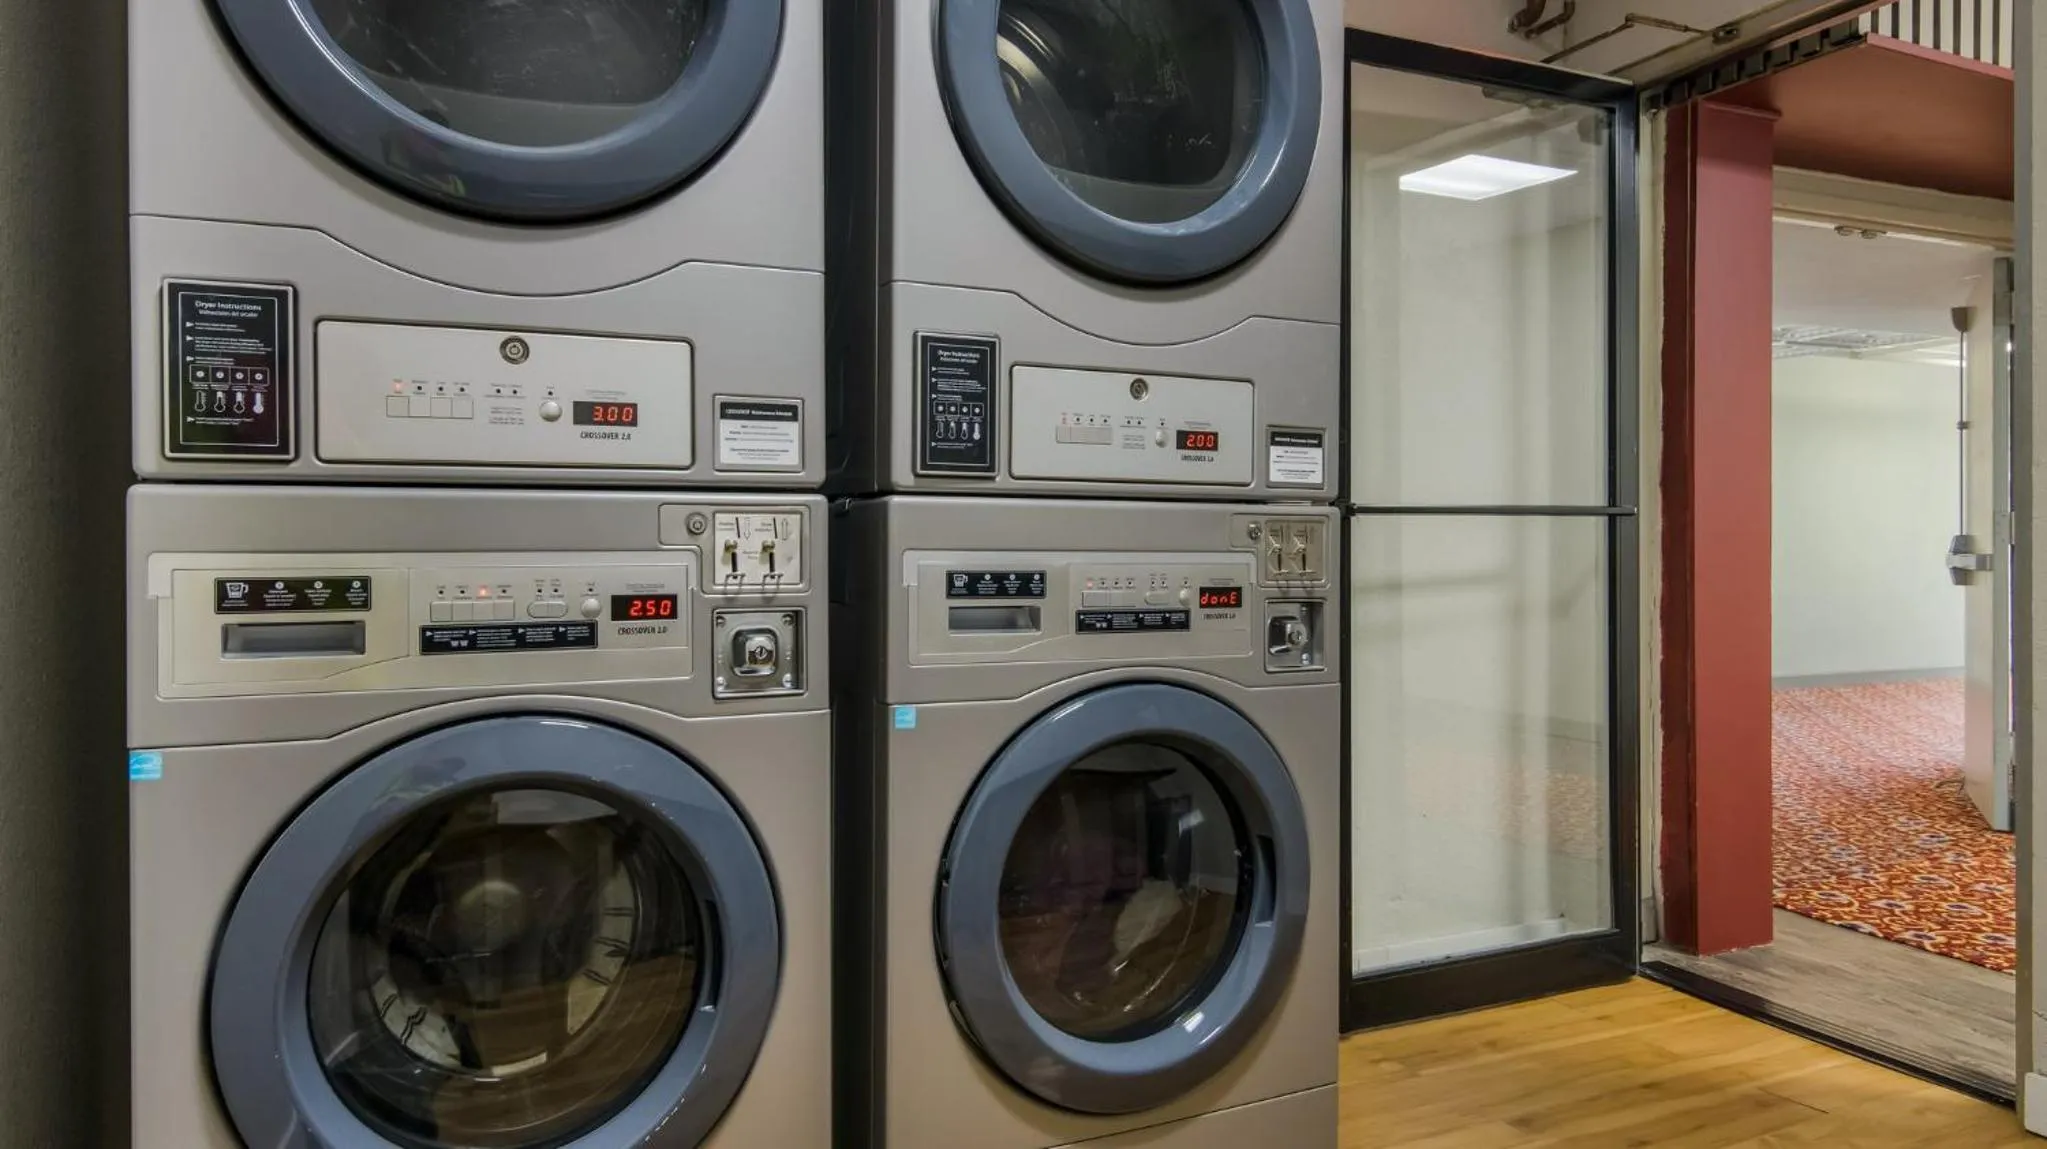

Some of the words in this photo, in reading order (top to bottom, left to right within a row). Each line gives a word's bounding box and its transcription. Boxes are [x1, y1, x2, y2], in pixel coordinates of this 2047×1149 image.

[194, 300, 217, 310] Dryer
[217, 301, 262, 311] Instructions
[580, 430, 619, 441] CROSSOVER
[631, 600, 672, 616] 2.50
[618, 626, 656, 635] CROSSOVER
